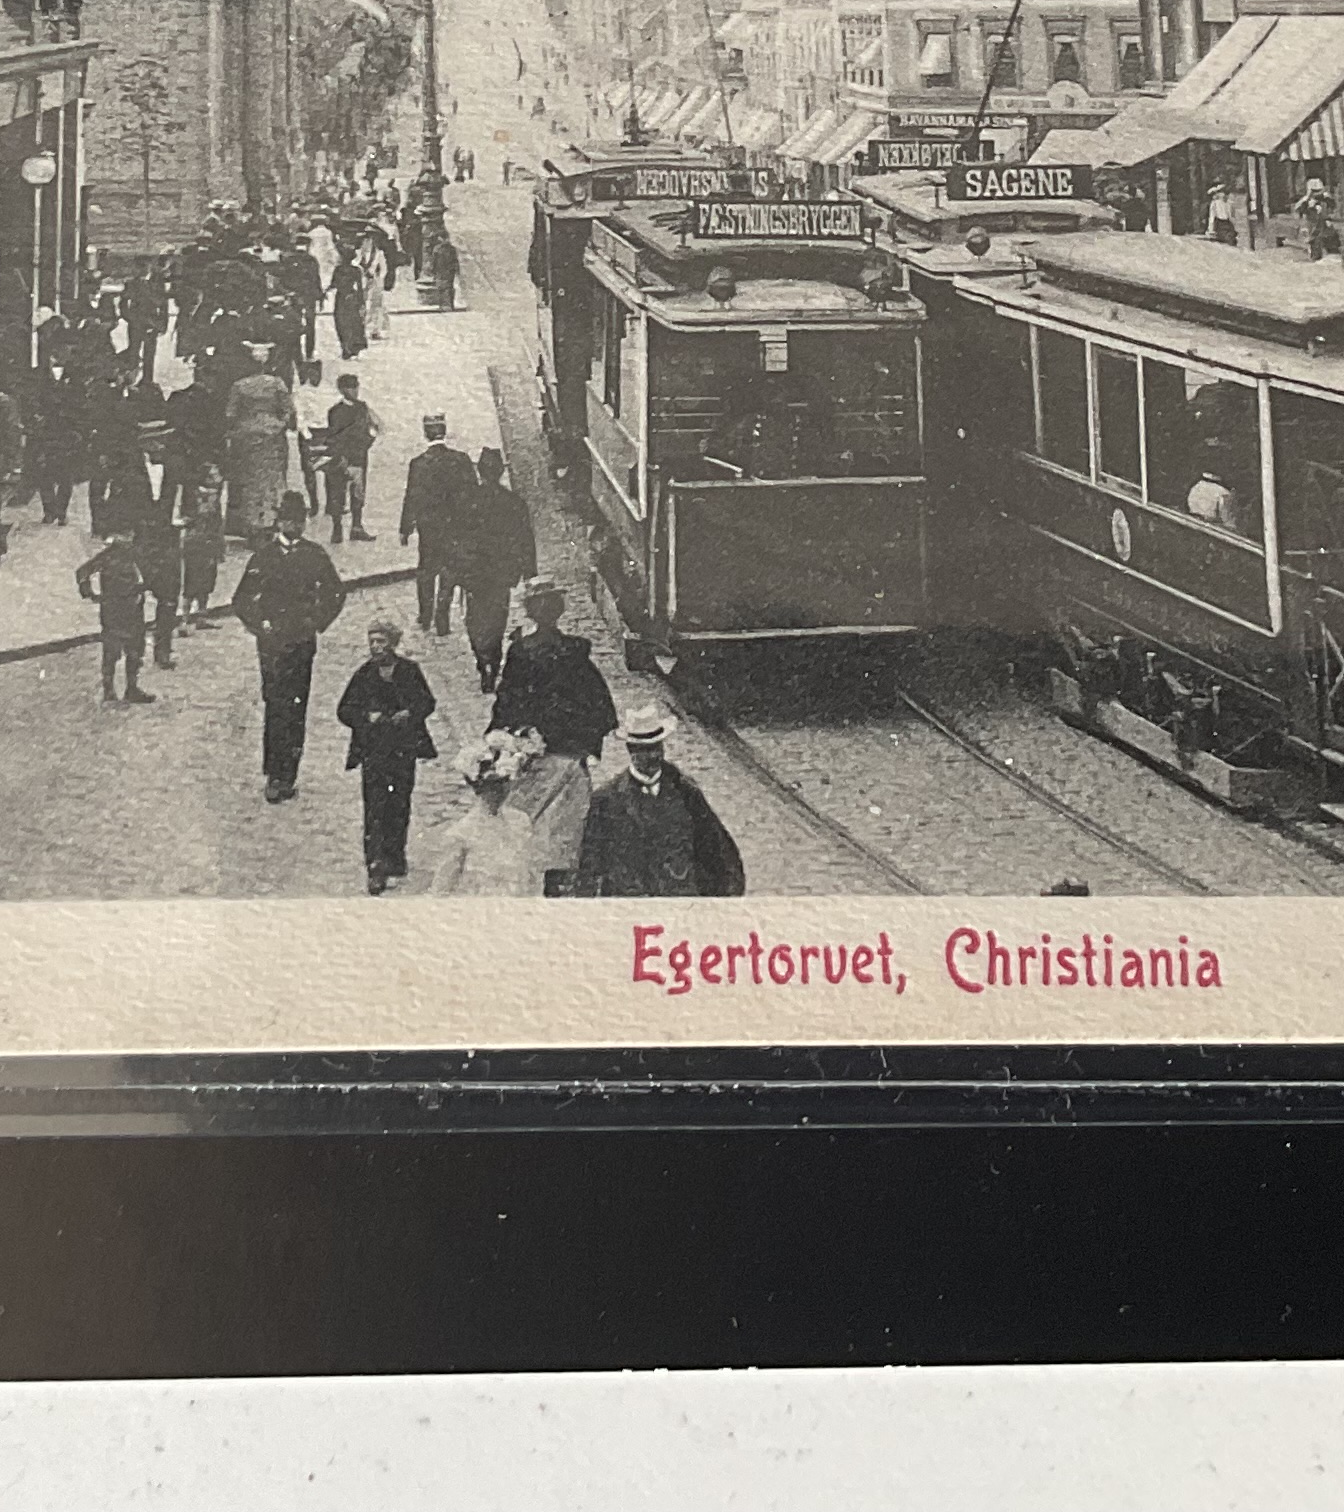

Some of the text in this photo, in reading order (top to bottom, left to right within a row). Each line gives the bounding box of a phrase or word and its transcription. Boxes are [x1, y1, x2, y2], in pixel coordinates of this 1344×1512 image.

[965, 168, 1074, 199] SAGENE
[632, 924, 1223, 995] Egertorvet, Christiania
